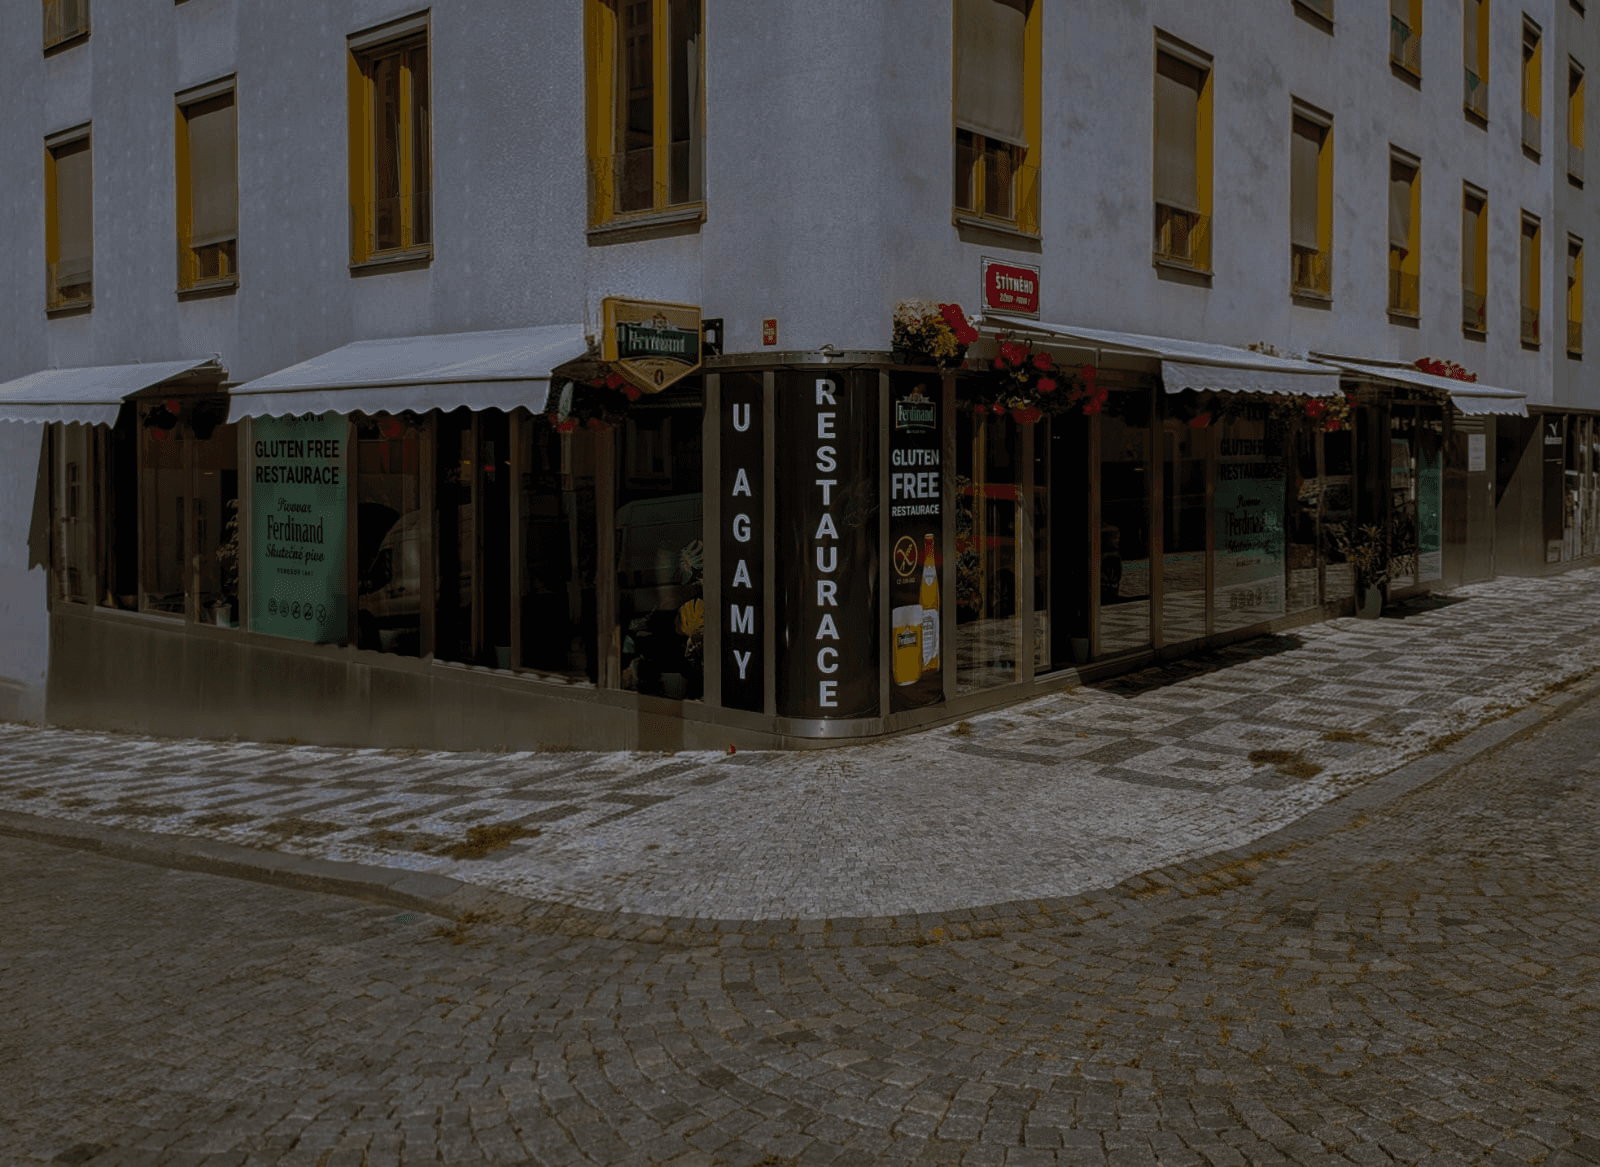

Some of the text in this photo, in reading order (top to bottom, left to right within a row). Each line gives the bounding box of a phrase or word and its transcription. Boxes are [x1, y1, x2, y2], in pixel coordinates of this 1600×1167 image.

[254, 440, 340, 458] GLUTEN FREE
[892, 448, 940, 466] GLUTEN
[255, 466, 340, 485] RESTAURACE
[891, 471, 940, 500] FREE
[891, 503, 940, 517] RESTAURACE
[267, 514, 324, 544] Ferdinand
[730, 403, 755, 680] U AGAMY
[815, 378, 840, 708] RESTAURACE
